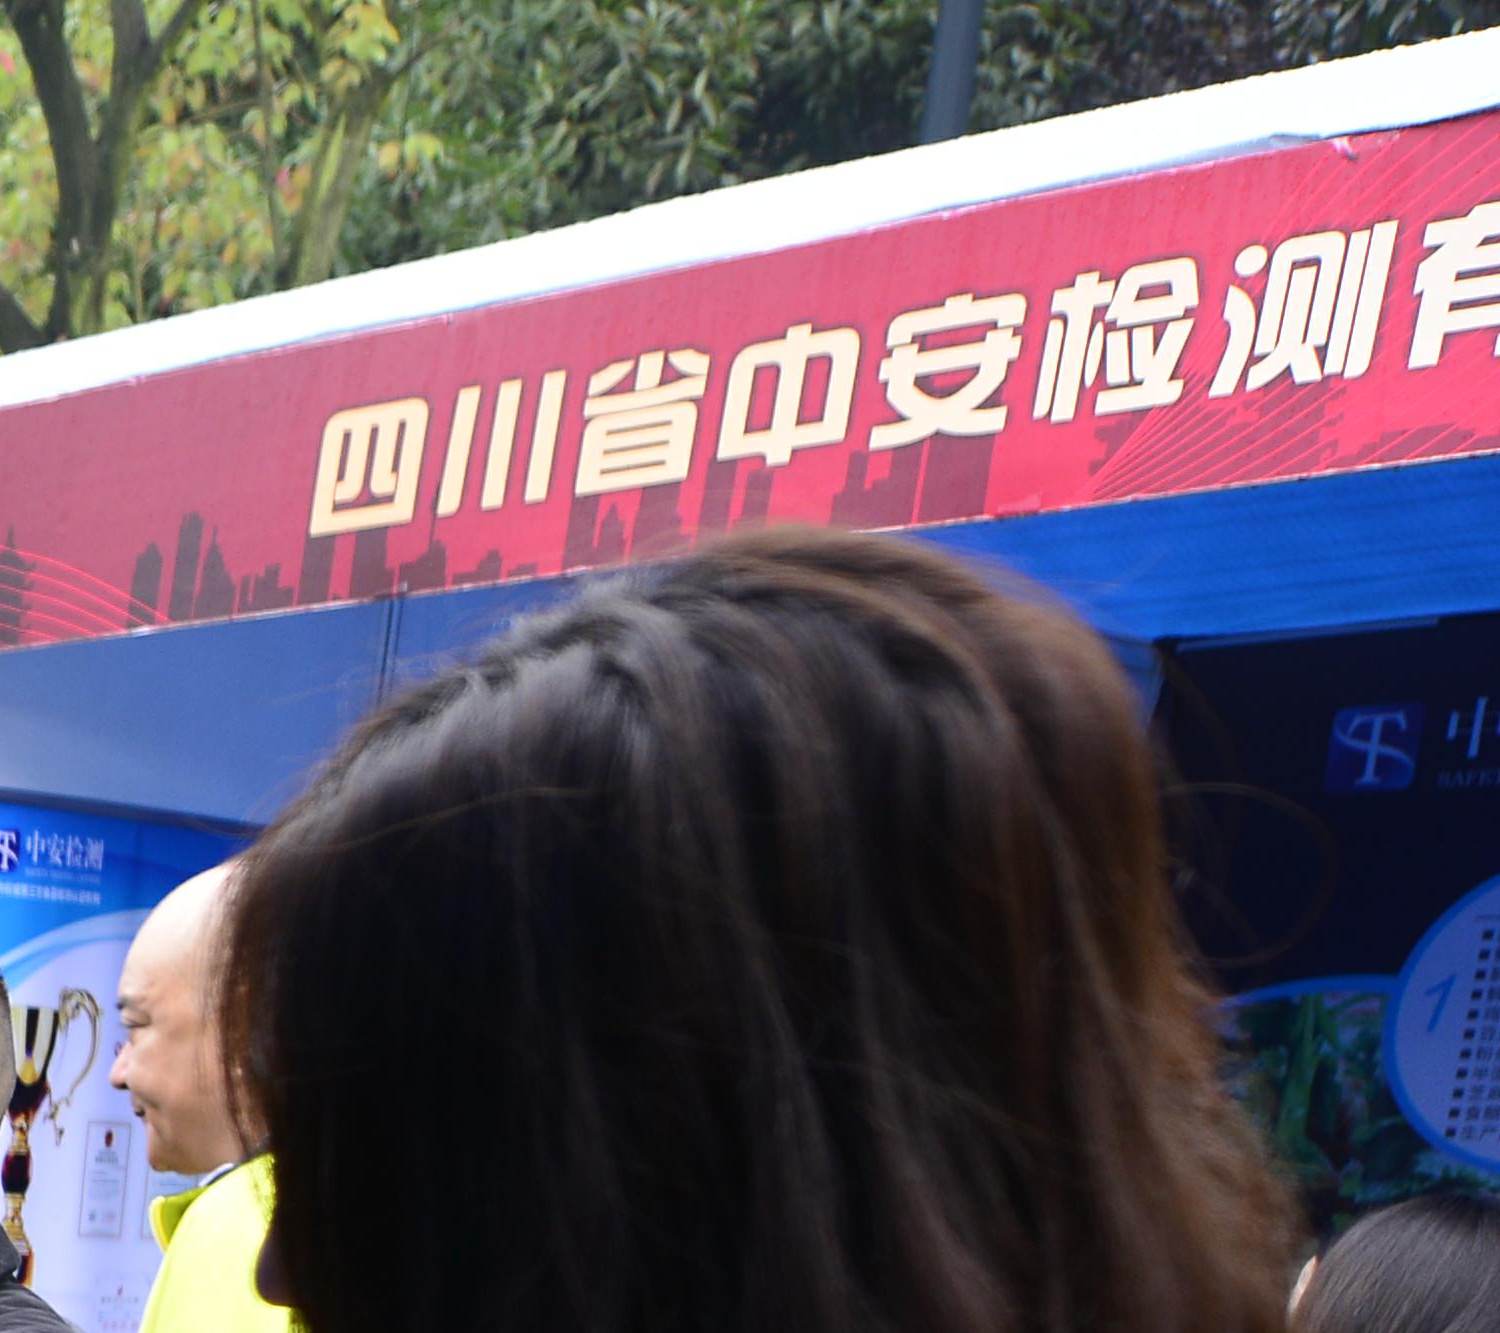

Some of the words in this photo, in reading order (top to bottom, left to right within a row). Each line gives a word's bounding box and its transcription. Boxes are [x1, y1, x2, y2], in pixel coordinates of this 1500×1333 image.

[308, 200, 1500, 539] 四川省中安检测有
